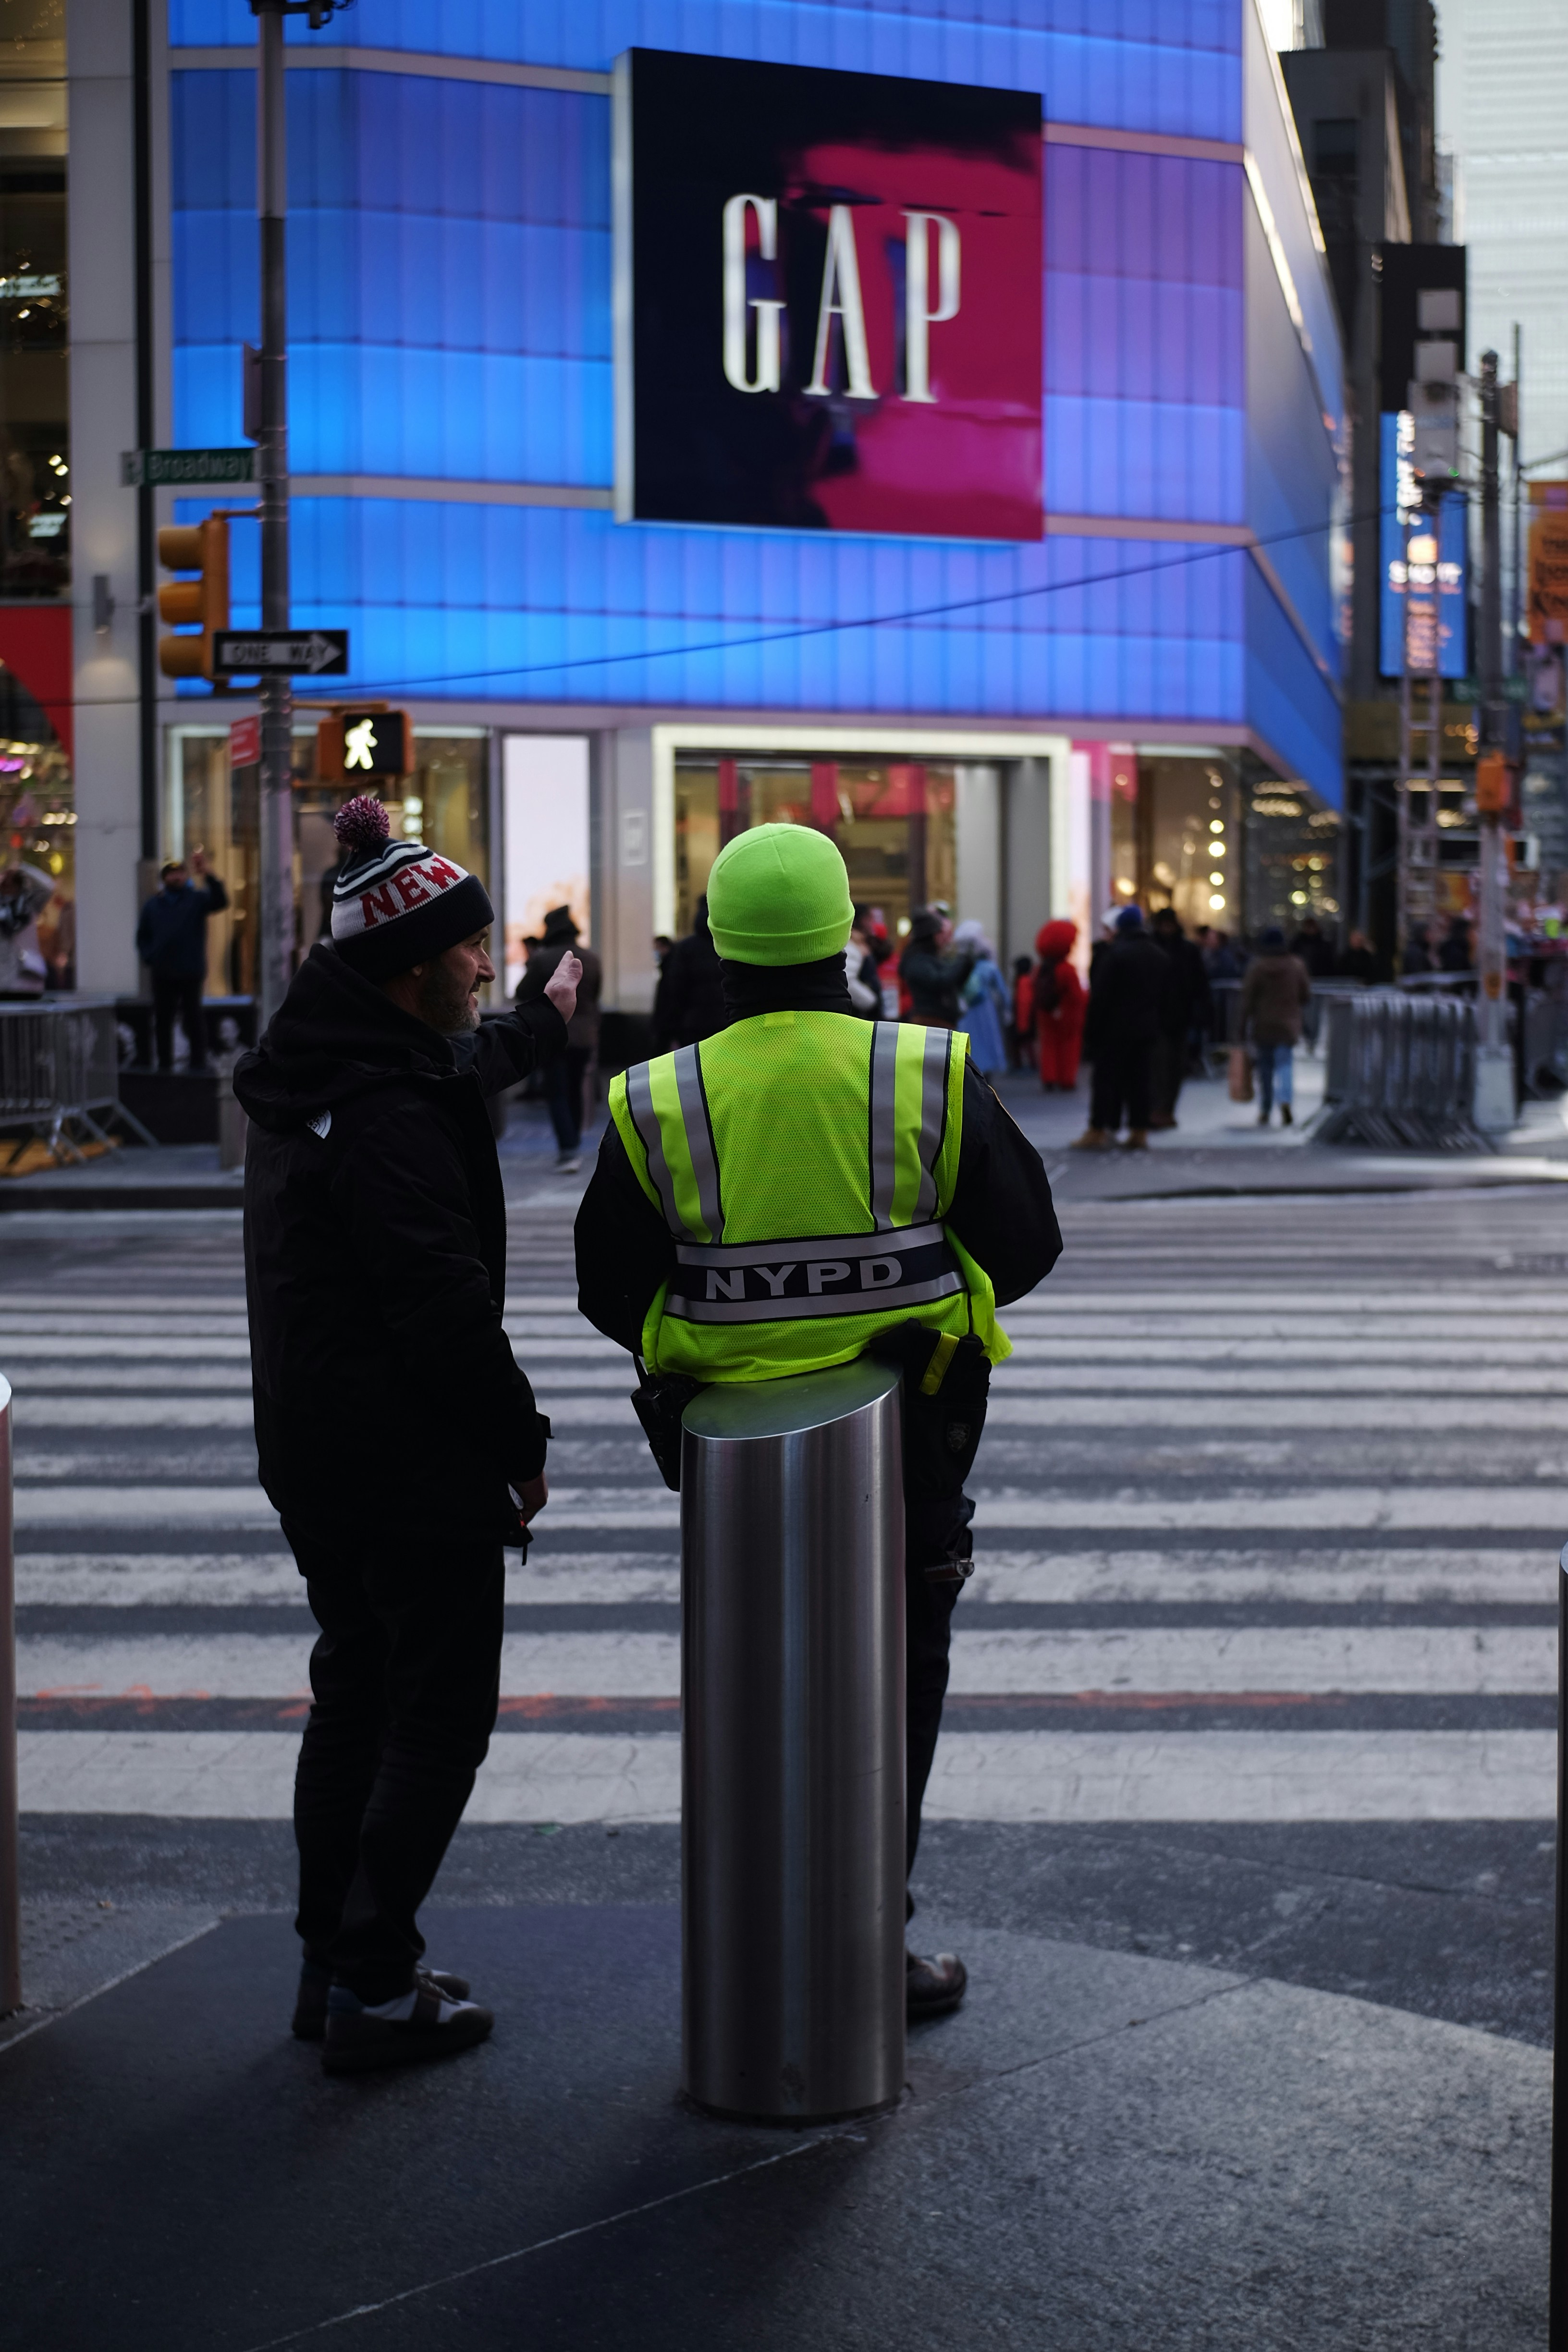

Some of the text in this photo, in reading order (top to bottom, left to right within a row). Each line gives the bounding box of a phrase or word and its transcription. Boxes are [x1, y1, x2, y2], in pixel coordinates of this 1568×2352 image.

[722, 194, 961, 404] GAP
[147, 451, 251, 482] Broadway
[231, 644, 329, 663] ONE WAY
[359, 857, 460, 927] NEW
[706, 1256, 903, 1299] NYPD
